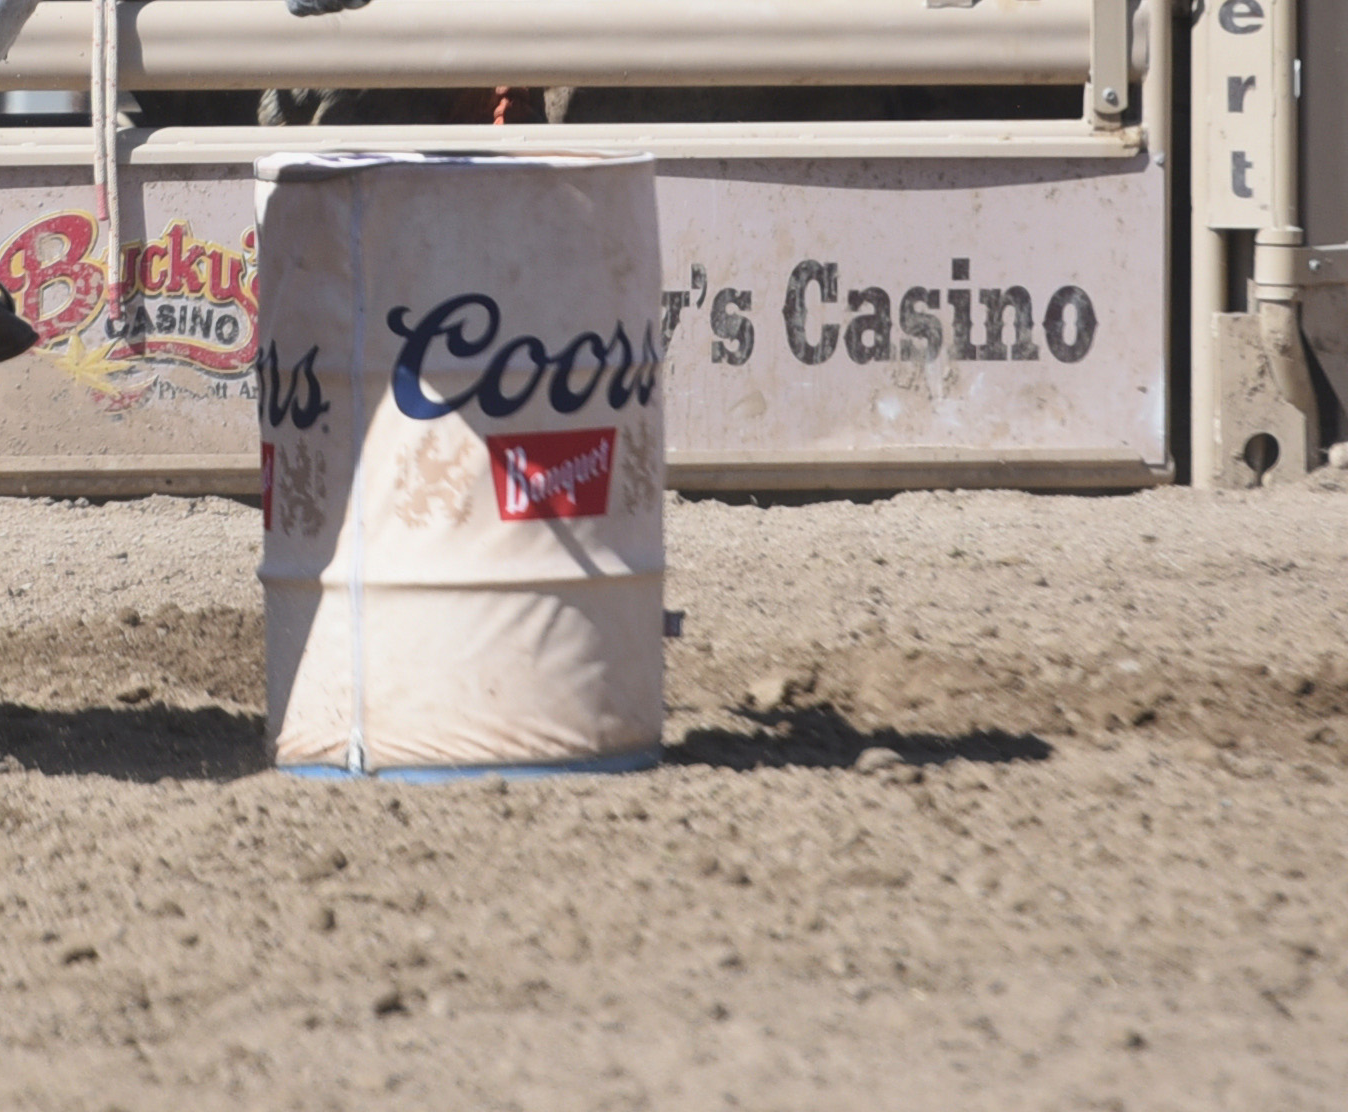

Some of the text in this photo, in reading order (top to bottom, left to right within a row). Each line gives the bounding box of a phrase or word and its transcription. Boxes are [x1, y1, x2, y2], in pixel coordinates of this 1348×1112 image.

[105, 303, 241, 346] CASINO
[782, 257, 1099, 366] Casino
[502, 438, 614, 516] Banquet
